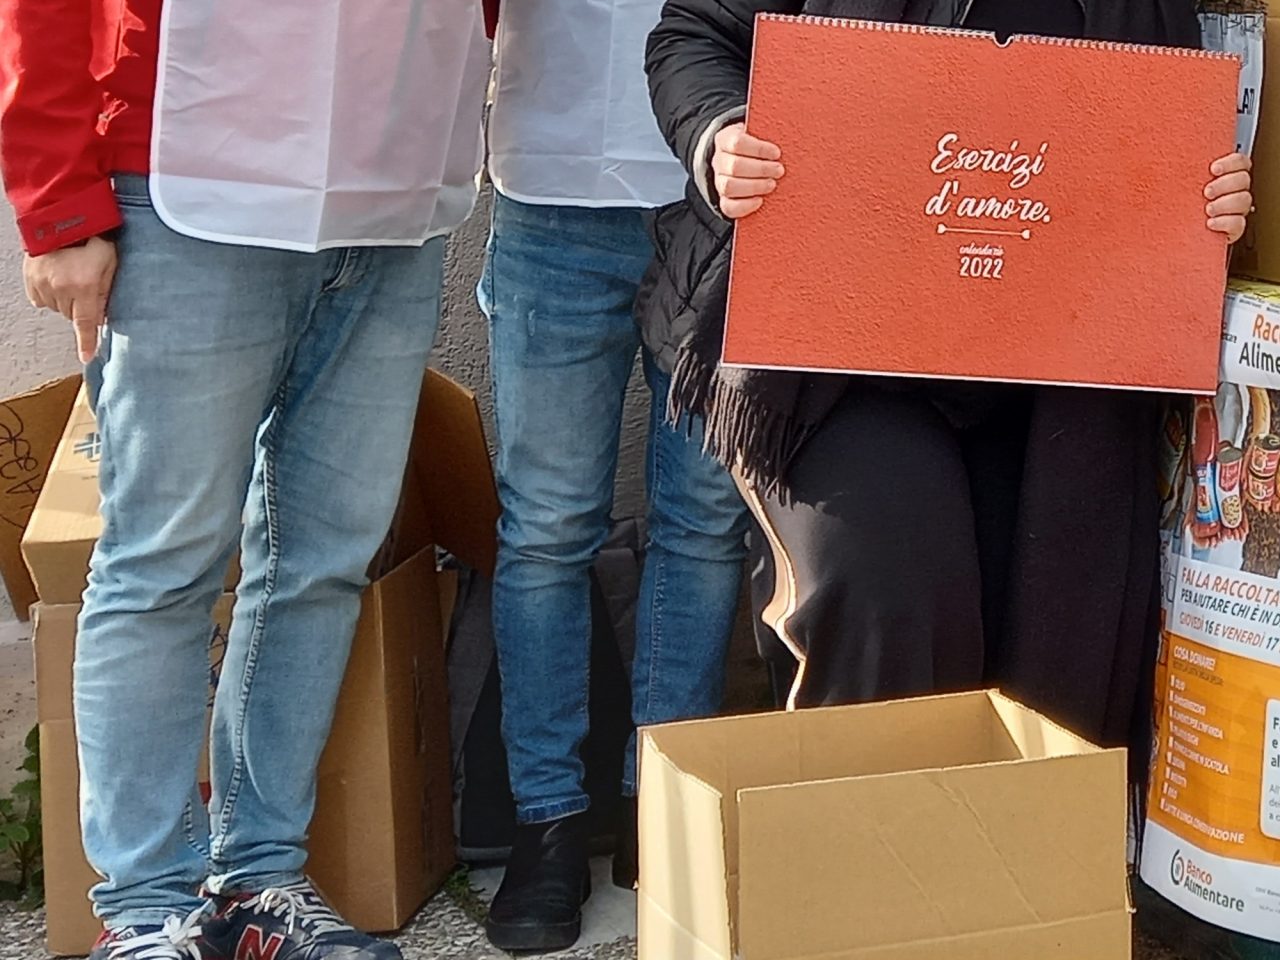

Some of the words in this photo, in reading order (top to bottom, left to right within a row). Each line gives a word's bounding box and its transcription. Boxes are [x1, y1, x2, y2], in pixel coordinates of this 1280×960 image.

[930, 132, 1048, 189] Esercizi
[925, 181, 1051, 223] d'amore.
[959, 243, 1004, 255] calendario
[960, 256, 1003, 279] 2022
[1213, 575, 1280, 608] RACCOLTA
[1231, 602, 1250, 618] CHI
[1259, 609, 1272, 624] IN
[1205, 620, 1214, 635] 16
[1266, 636, 1280, 650] 17
[1271, 755, 1280, 768] al
[1186, 859, 1212, 885] Banco
[1183, 875, 1245, 913] Alimentare
